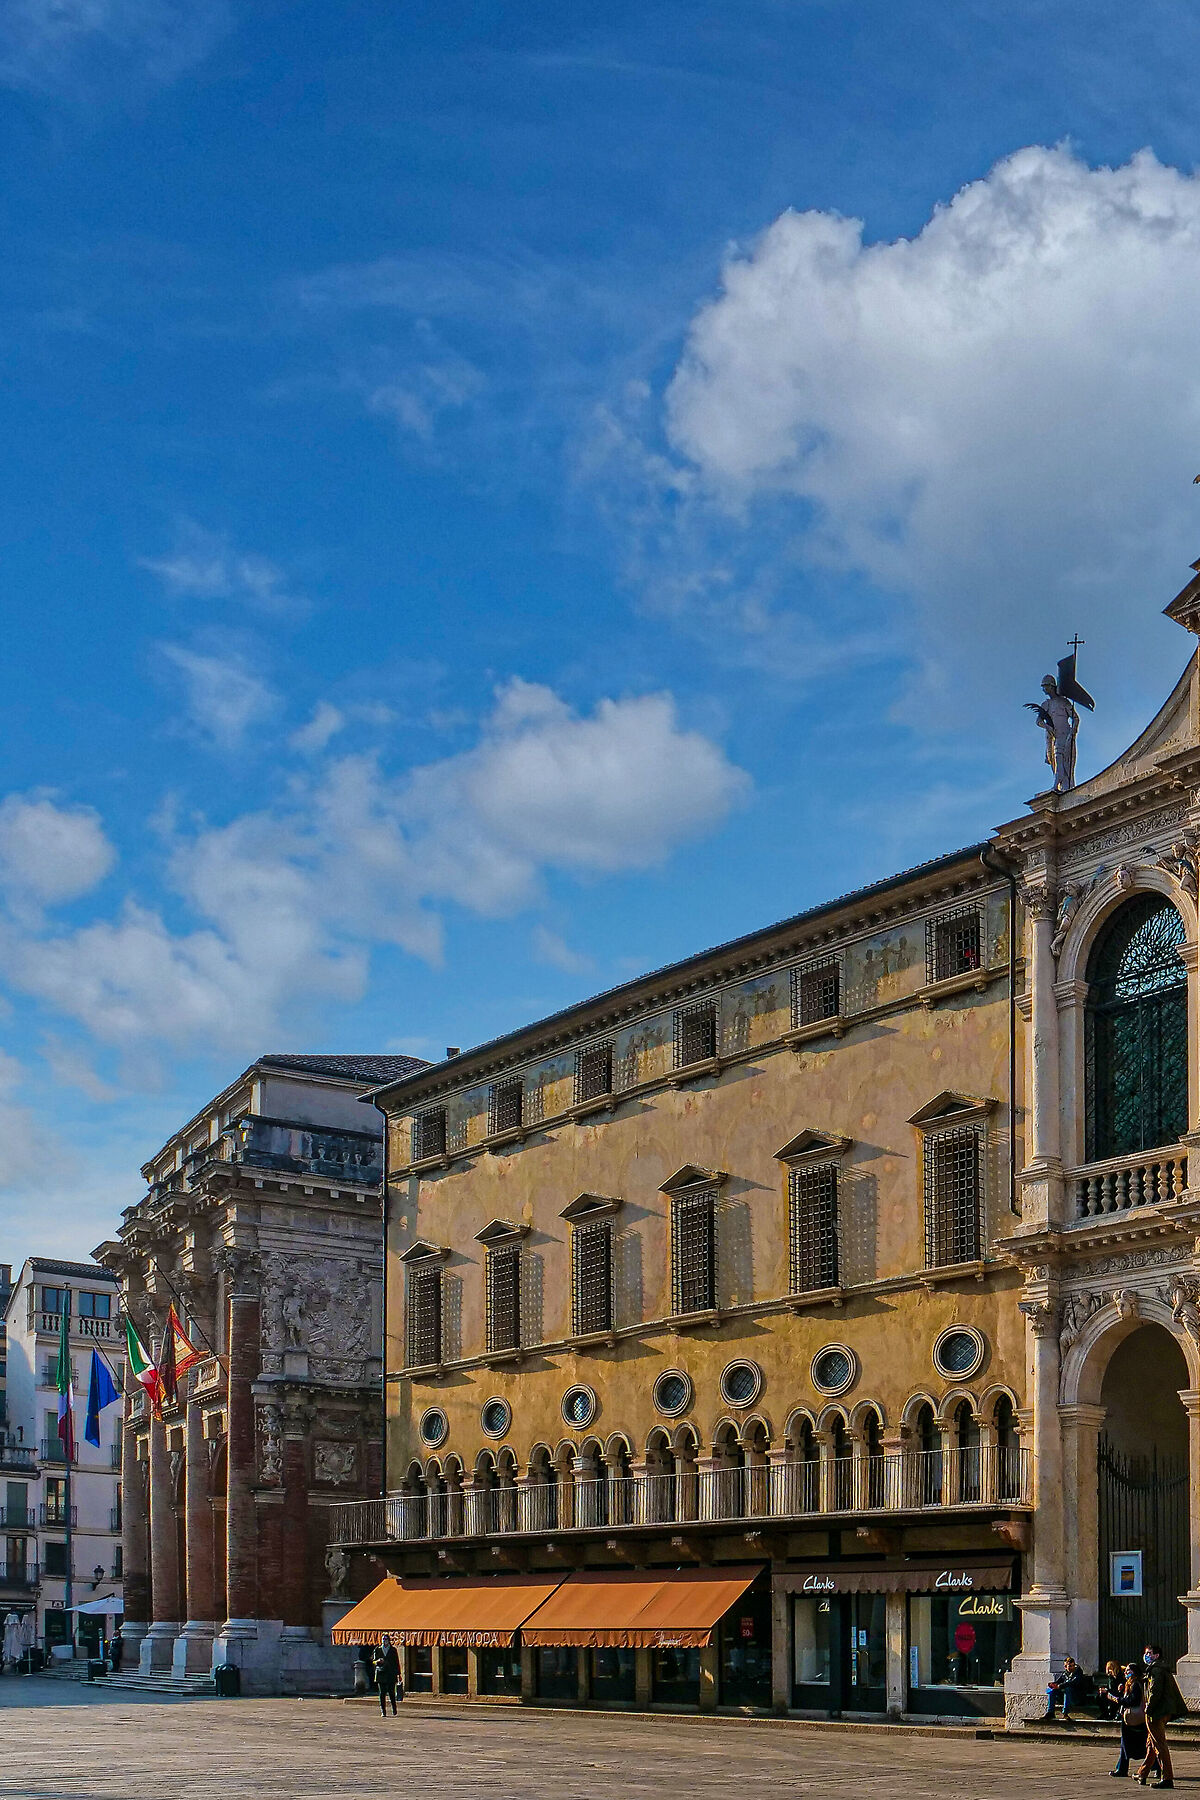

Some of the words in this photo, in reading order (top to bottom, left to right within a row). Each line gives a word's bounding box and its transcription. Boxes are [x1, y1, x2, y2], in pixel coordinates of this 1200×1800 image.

[803, 1574, 835, 1590] Clarks
[935, 1570, 973, 1588] Clarks
[958, 1596, 1004, 1616] Clarks
[387, 1631, 421, 1644] ESSUTI
[440, 1631, 463, 1645] ALTA
[467, 1631, 499, 1645] MODA
